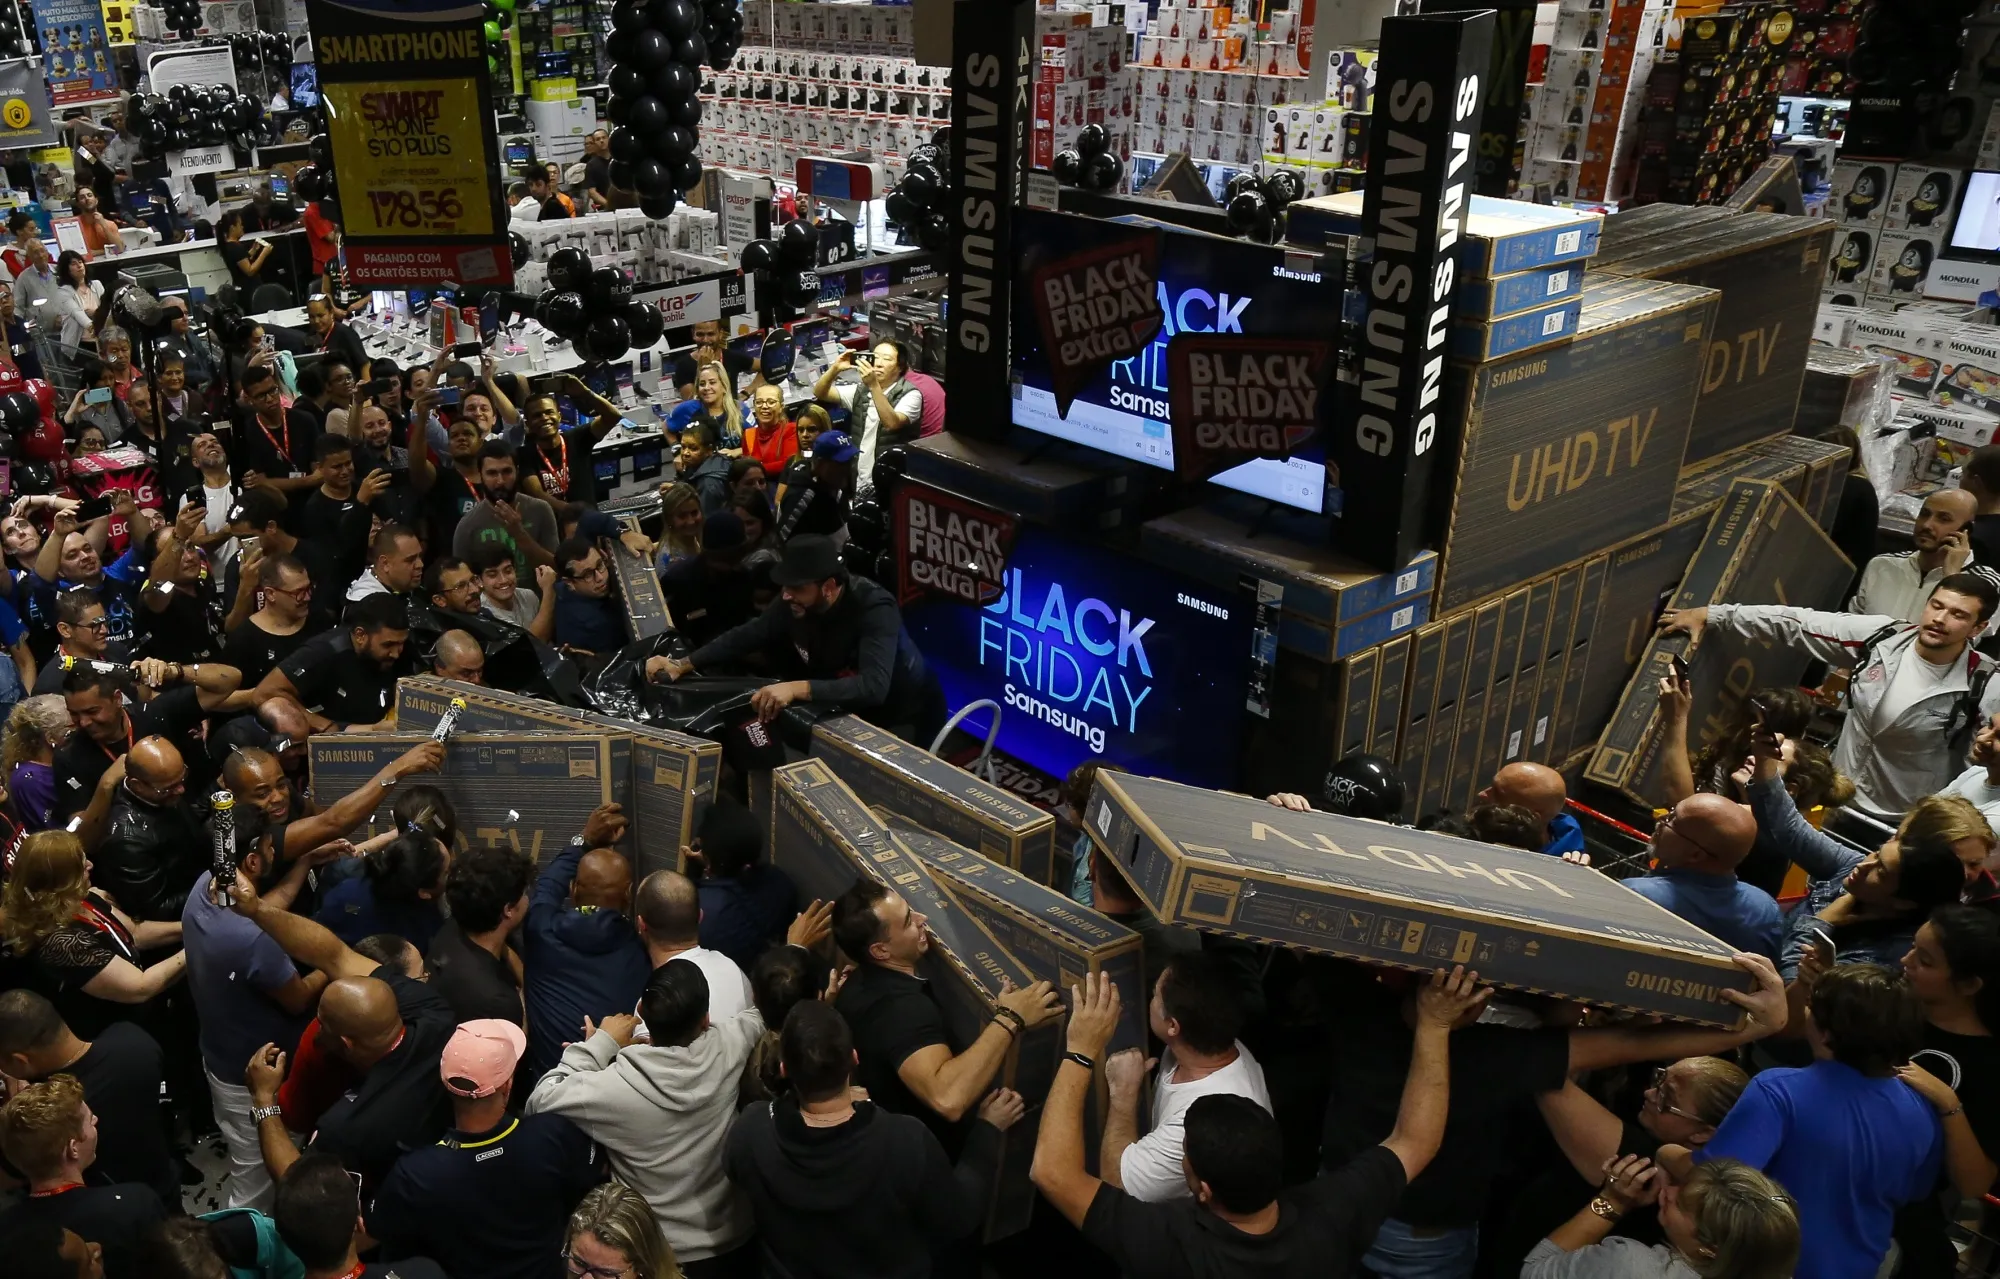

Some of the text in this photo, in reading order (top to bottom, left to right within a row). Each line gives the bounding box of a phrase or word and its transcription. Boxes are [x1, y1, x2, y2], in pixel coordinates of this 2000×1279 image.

[319, 29, 480, 65] SMARTPHONE
[1015, 37, 1029, 113] 4K
[361, 90, 444, 121] SMART
[1860, 98, 1900, 106] MONDIAL
[373, 117, 436, 135] PHONE
[368, 134, 451, 157] S10 PLUS
[726, 194, 744, 205] extra
[961, 53, 1000, 353] SAMSUNG
[356, 266, 454, 278] OS CARTÕES EXTRA
[364, 253, 441, 264] PAGANDO COM
[910, 264, 931, 274] Preços
[1355, 79, 1433, 457] SAMSUNG
[1414, 74, 1478, 456] SAMSUNG
[731, 283, 738, 295] SÓ
[1044, 253, 1150, 307] BLACK
[1939, 274, 1980, 285] MONDIAL
[1051, 282, 1156, 338] FRIDAY
[1060, 326, 1132, 366] extra
[1856, 324, 1906, 338] MONDIAL
[1737, 322, 1781, 383] TV
[1949, 342, 1997, 359] MONDIAL
[1188, 353, 1315, 389] BLACK
[1491, 359, 1547, 388] SAMSUNG
[1192, 386, 1318, 421] FRIDAY
[1196, 420, 1281, 450] extra
[1507, 407, 1658, 513] UHD TV
[909, 498, 1001, 555] BLACK
[1717, 488, 1753, 546] SAMSUNG
[909, 525, 1004, 582] FRIDAY
[1616, 539, 1662, 567] SAMSUNG
[911, 559, 975, 600] extra
[1177, 592, 1229, 620] SAMSUNG
[980, 616, 1152, 733] FRIDAY
[405, 695, 451, 716] SAMSU
[1004, 683, 1105, 753] Samsung
[318, 750, 374, 763] SAMSUNG
[779, 794, 825, 847] SAMSUNG
[966, 787, 1029, 821] SAMSUNG
[1251, 821, 1370, 861] TV
[1366, 843, 1575, 899] UHD
[1046, 905, 1113, 940] SAMSUNG
[1406, 929, 1418, 943] 2
[1604, 924, 1725, 955] SAMSUNG
[1625, 970, 1731, 1006] AMSUNG
[478, 1149, 501, 1160] LACOSTE
